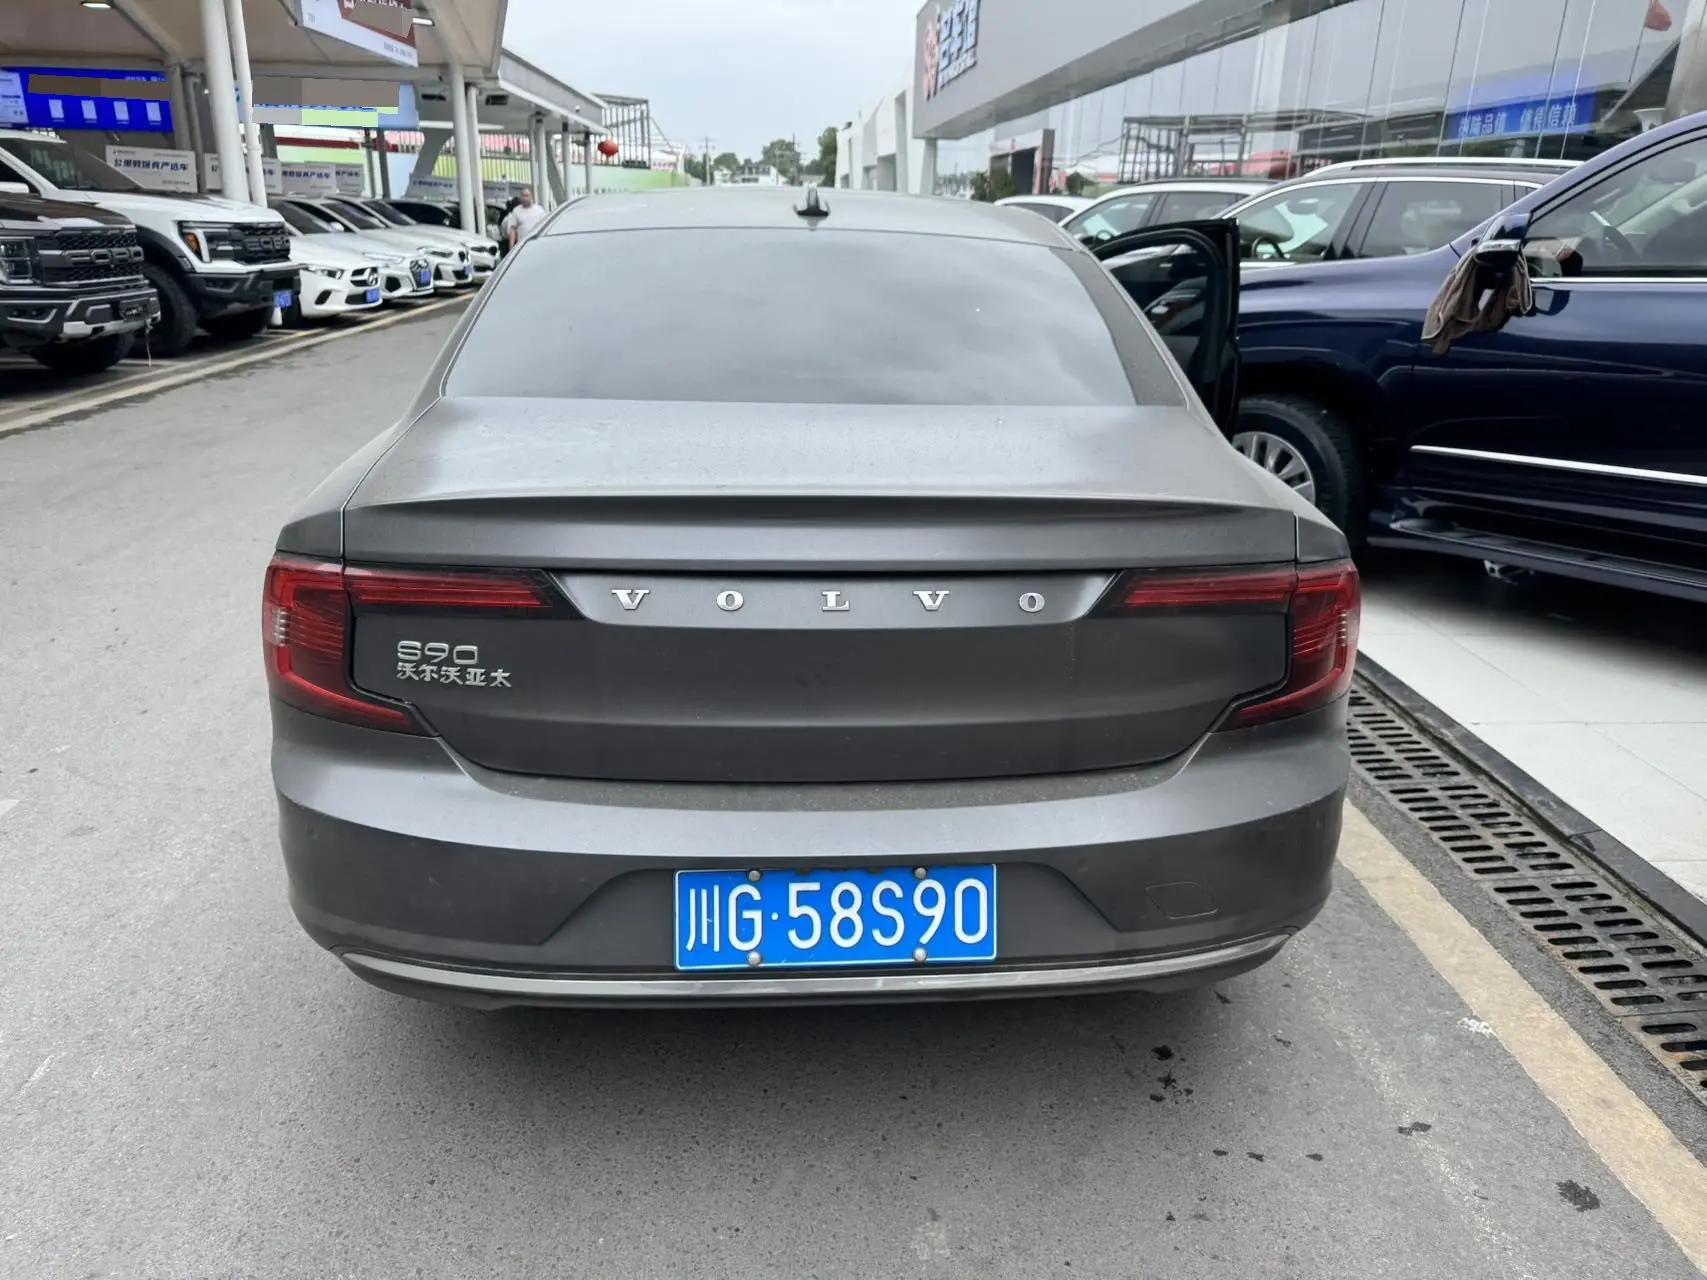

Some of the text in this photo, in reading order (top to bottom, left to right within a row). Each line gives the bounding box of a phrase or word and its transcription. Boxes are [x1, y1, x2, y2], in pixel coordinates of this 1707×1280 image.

[611, 589, 1046, 613] VOLVO
[397, 640, 478, 665] S90
[396, 661, 512, 688] 沃尔沃亚太
[686, 877, 988, 951] 川G·58S90
